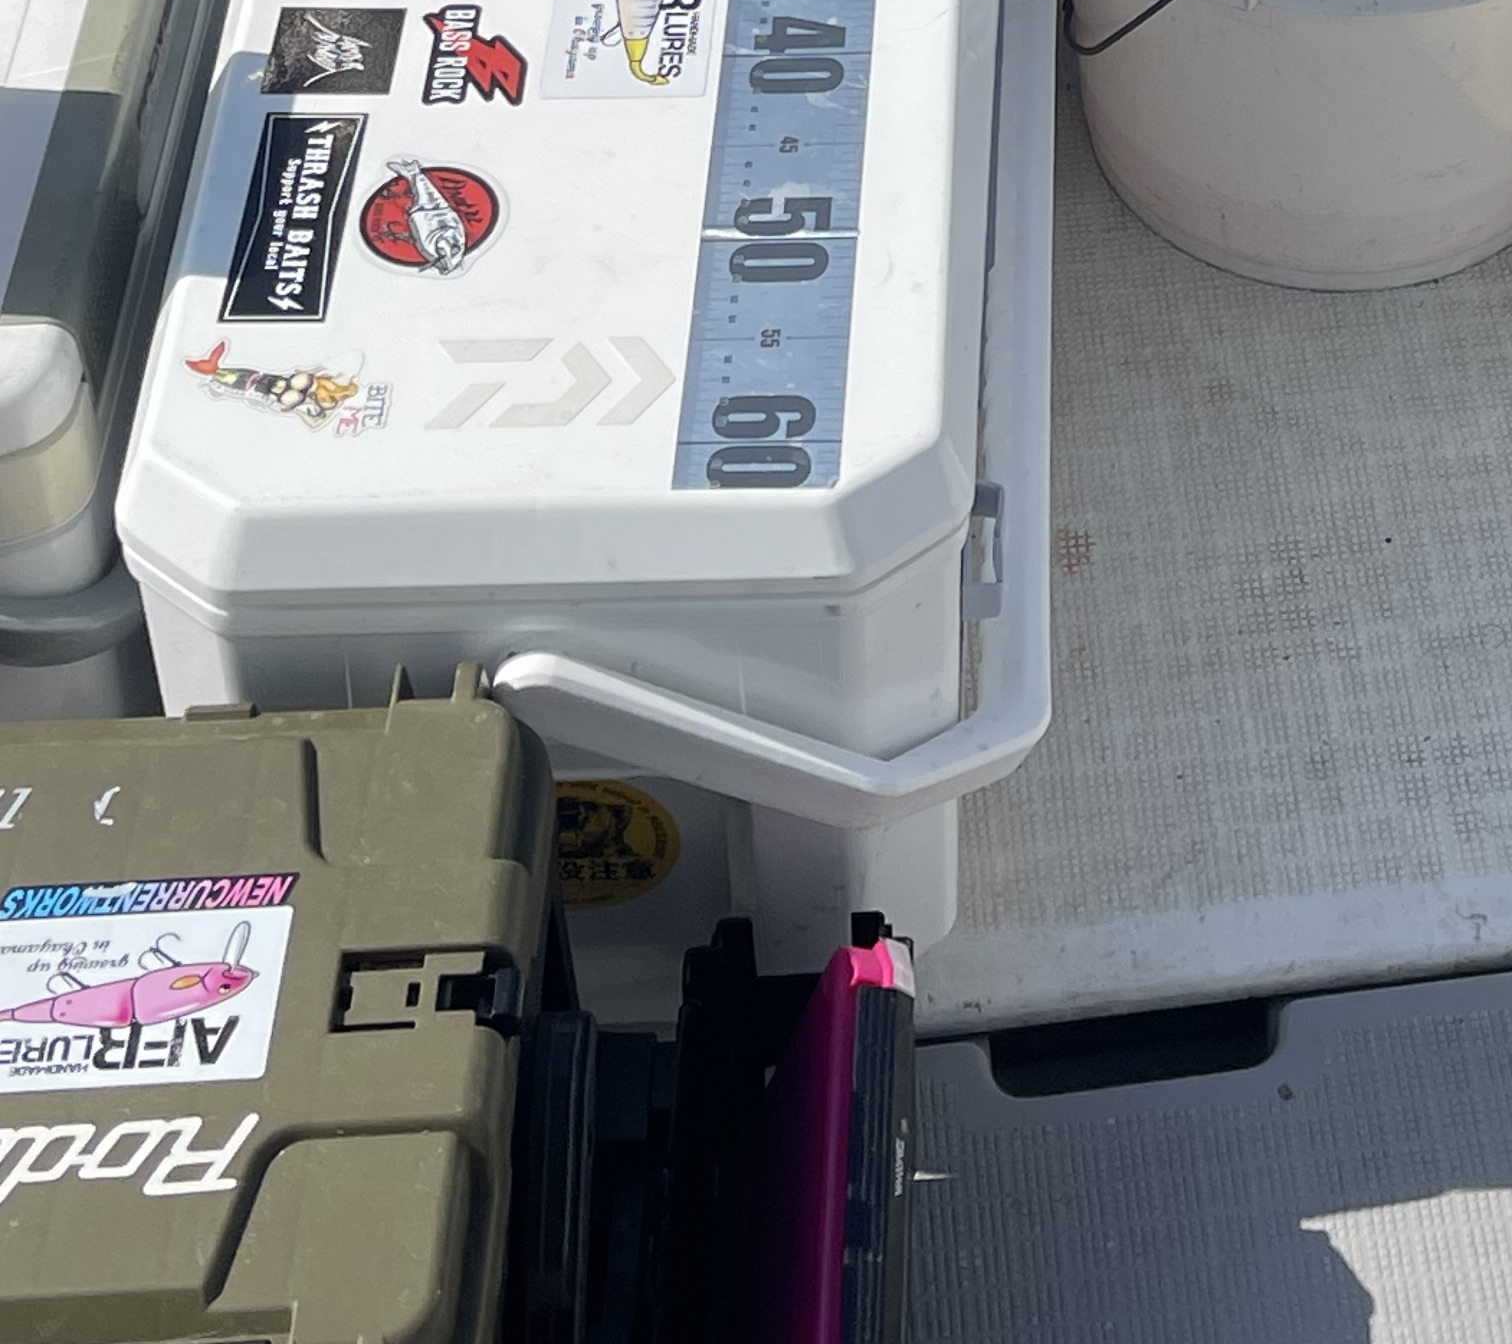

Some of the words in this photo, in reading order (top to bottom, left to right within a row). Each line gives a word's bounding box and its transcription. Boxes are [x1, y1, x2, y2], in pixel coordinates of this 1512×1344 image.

[438, 9, 477, 52] BASS
[658, 12, 689, 79] LURES
[750, 16, 847, 94] 40
[429, 56, 468, 100] ROCK
[779, 135, 799, 154] 45
[279, 158, 302, 206] Support
[292, 134, 334, 220] THRASH
[729, 196, 833, 283] 50
[275, 229, 314, 296] BAITS
[760, 328, 781, 348] 55
[336, 406, 363, 434] ME
[361, 384, 388, 427] BITE
[706, 395, 817, 488] 60
[0, 876, 293, 919] NEWCURRENTWORKS
[27, 961, 51, 973] up
